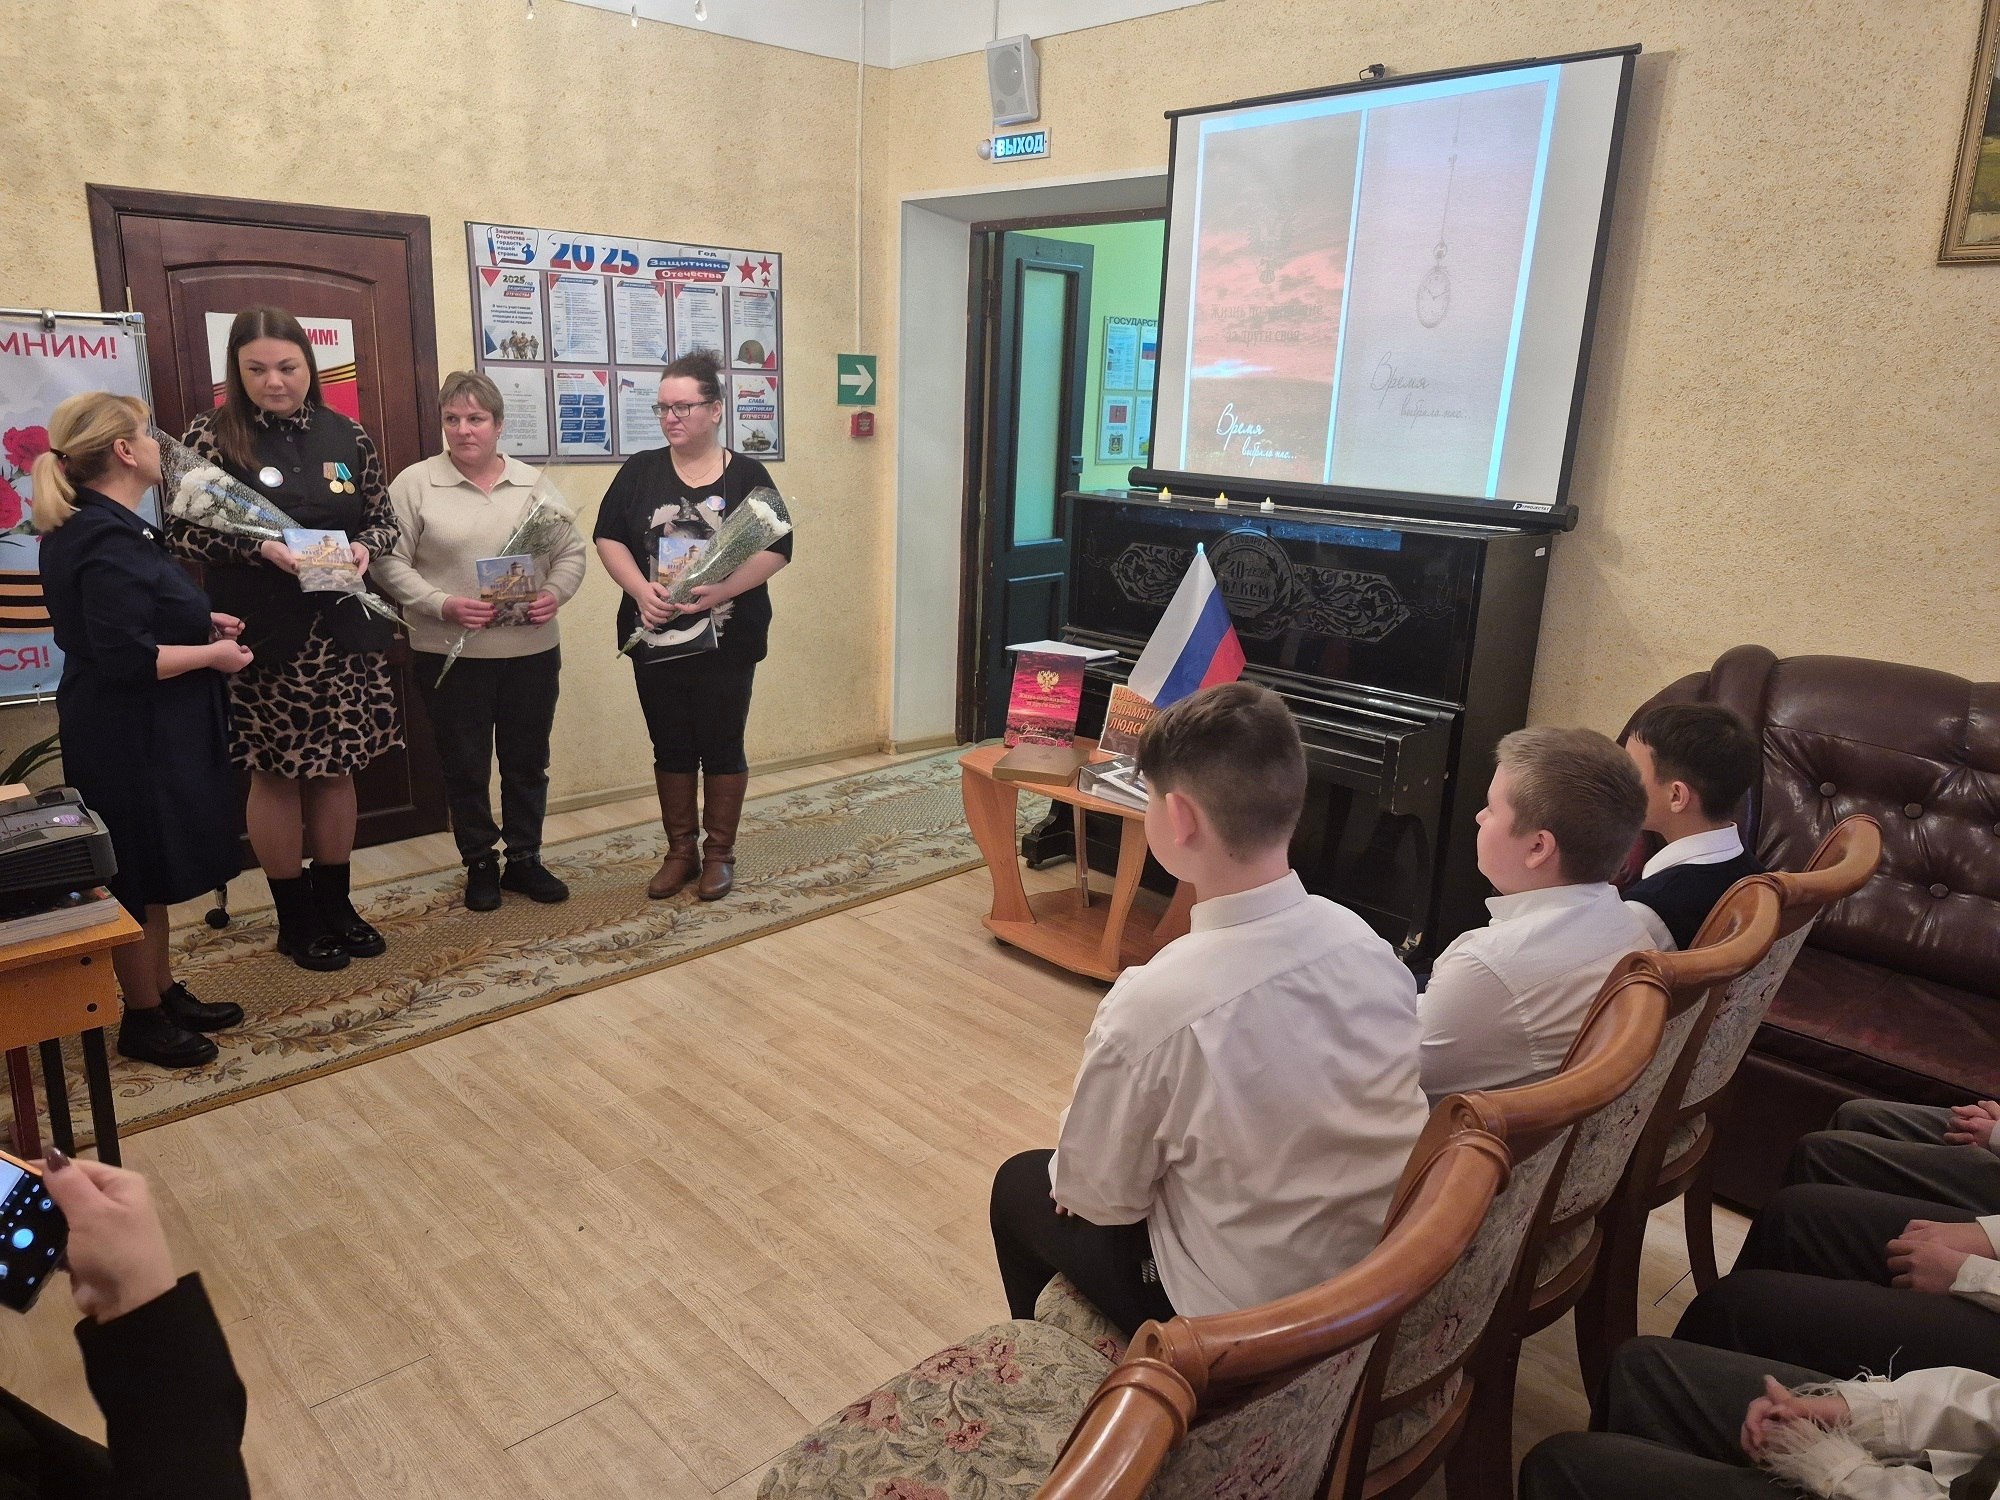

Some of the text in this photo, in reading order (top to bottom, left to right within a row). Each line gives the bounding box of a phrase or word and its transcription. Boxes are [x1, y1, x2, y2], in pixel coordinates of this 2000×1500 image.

[997, 134, 1044, 157] ВЫХОД
[697, 250, 717, 258] Год
[649, 259, 729, 269] Защитника
[503, 275, 525, 285] 2025
[661, 271, 723, 280] Отечества
[1109, 316, 1158, 327] ГОСУДАРСТ
[303, 328, 339, 346] ИМ!
[0, 332, 117, 360] МНИМ!
[1371, 351, 1430, 409] Время
[1216, 402, 1265, 451] Время
[1223, 580, 1269, 599] ВЛКСМ
[1110, 703, 1119, 713] В
